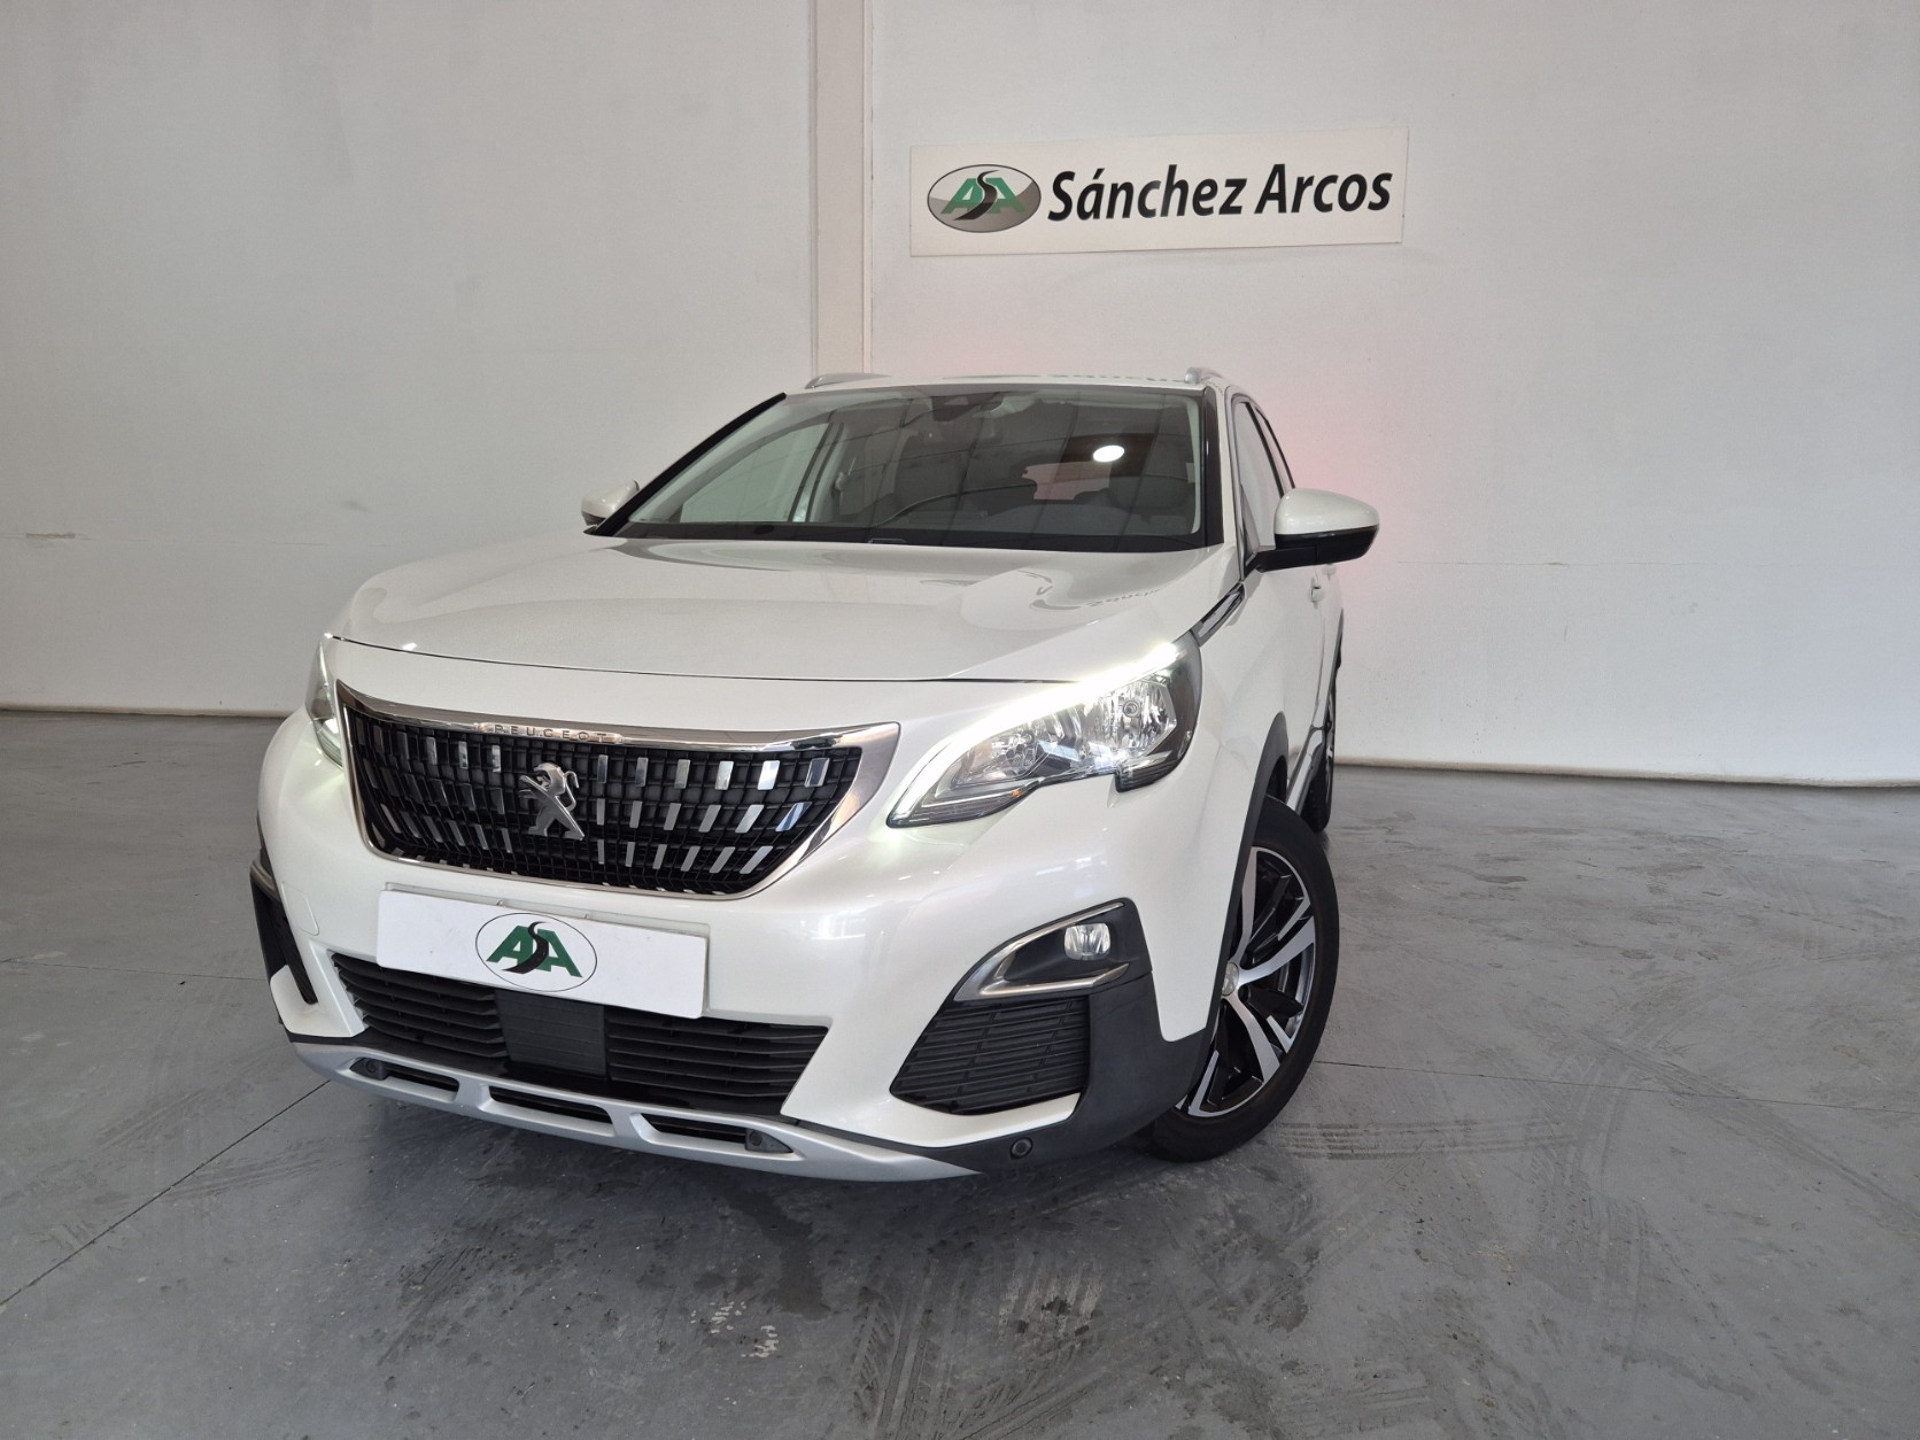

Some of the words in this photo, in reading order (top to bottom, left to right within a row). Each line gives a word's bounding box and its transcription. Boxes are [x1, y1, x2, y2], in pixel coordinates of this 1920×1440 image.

[941, 169, 1026, 221] ASA
[1047, 164, 1248, 222] Sánchez
[1254, 163, 1393, 215] Arcos
[494, 724, 607, 743] PEUGEOT
[486, 920, 583, 979] ASA
